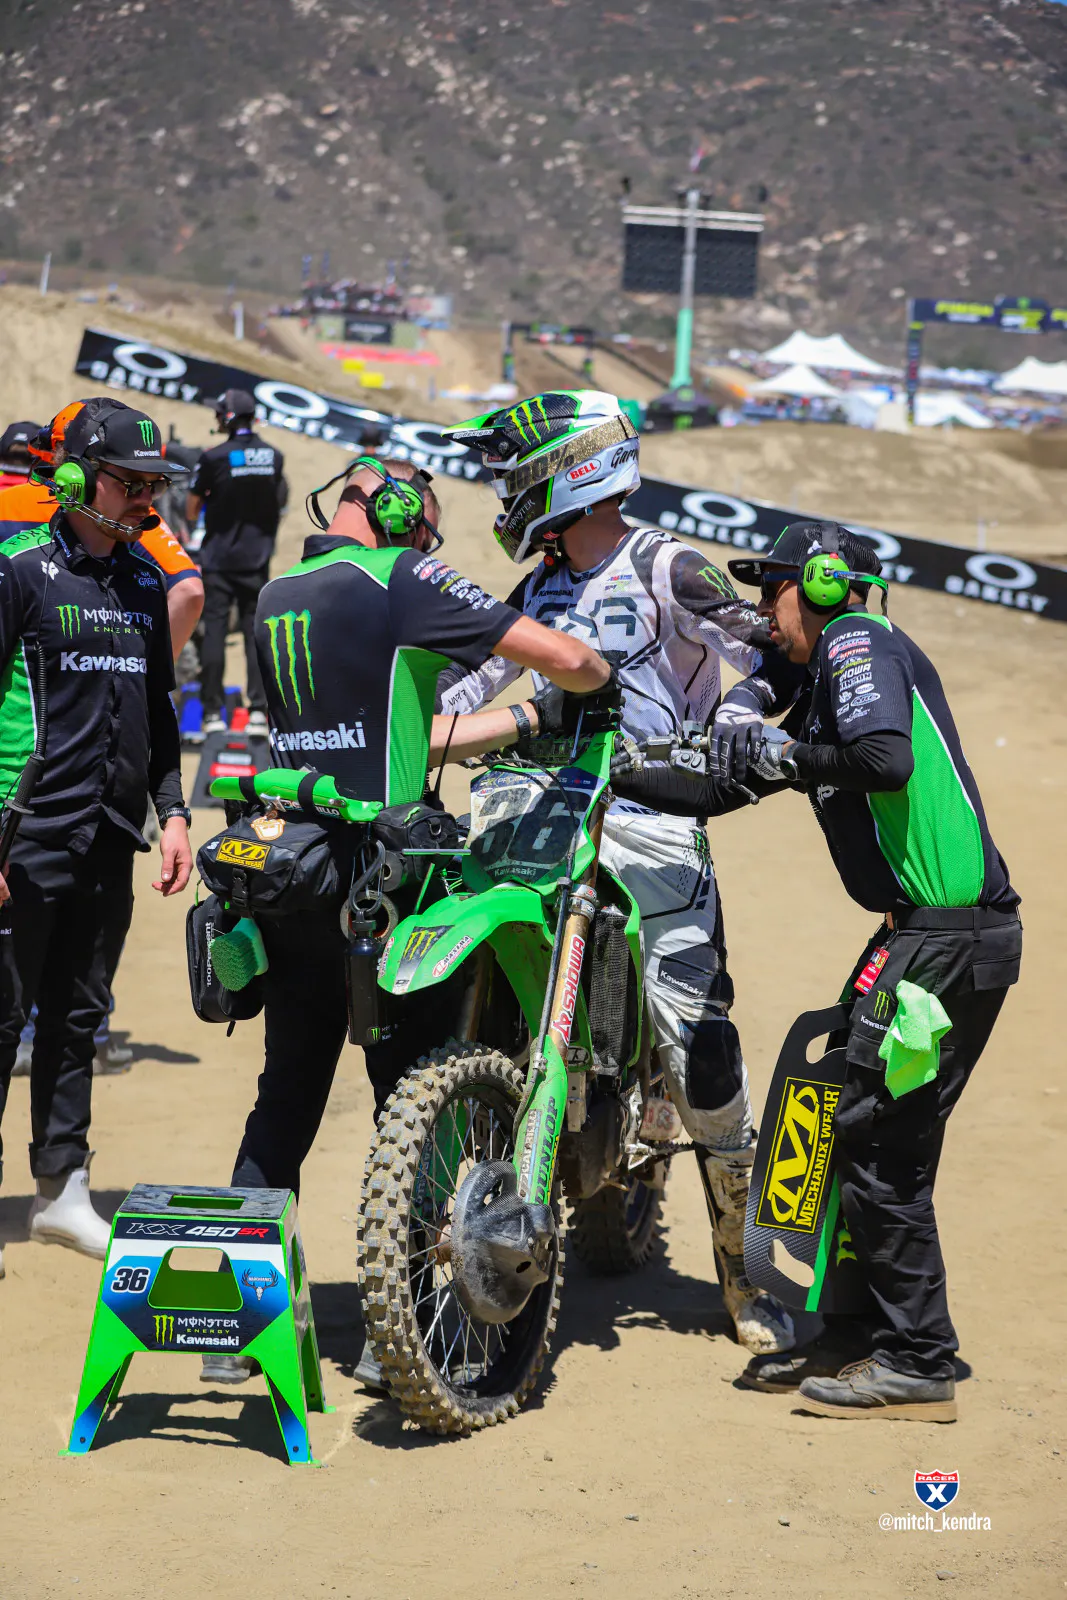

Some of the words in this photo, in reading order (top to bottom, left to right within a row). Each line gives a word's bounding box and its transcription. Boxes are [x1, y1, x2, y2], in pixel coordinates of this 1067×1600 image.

[90, 360, 199, 402] OAKLEY
[569, 462, 598, 480] BELL
[658, 510, 770, 551] OAKLEY
[944, 575, 1049, 613] OAKLEY
[83, 607, 153, 631] MONSTER
[494, 868, 537, 877] Kawasaki
[563, 935, 586, 1013] SHOWA
[535, 1095, 558, 1205] DUNLOP
[795, 1141, 829, 1228] MECHANIX
[820, 1090, 840, 1140] WEAR
[126, 1222, 187, 1236] KX
[111, 1267, 150, 1295] 36
[177, 1316, 240, 1329] MONSTER
[176, 1333, 240, 1347] Kawasaki
